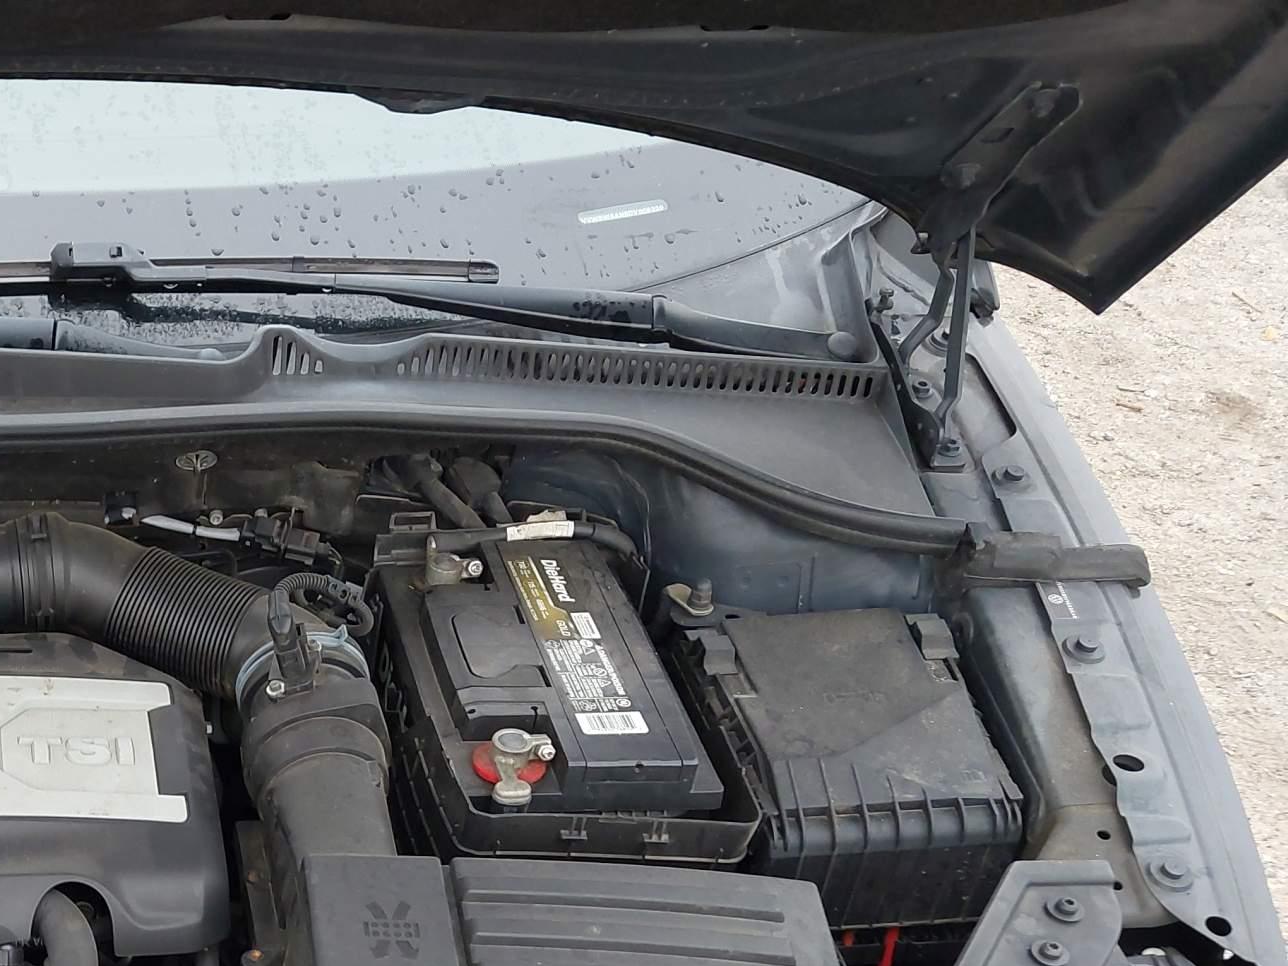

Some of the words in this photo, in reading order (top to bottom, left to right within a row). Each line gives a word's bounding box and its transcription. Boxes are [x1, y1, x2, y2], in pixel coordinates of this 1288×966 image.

[540, 559, 576, 602] DieHard
[555, 619, 572, 637] GOLD
[17, 735, 136, 766] TSI
